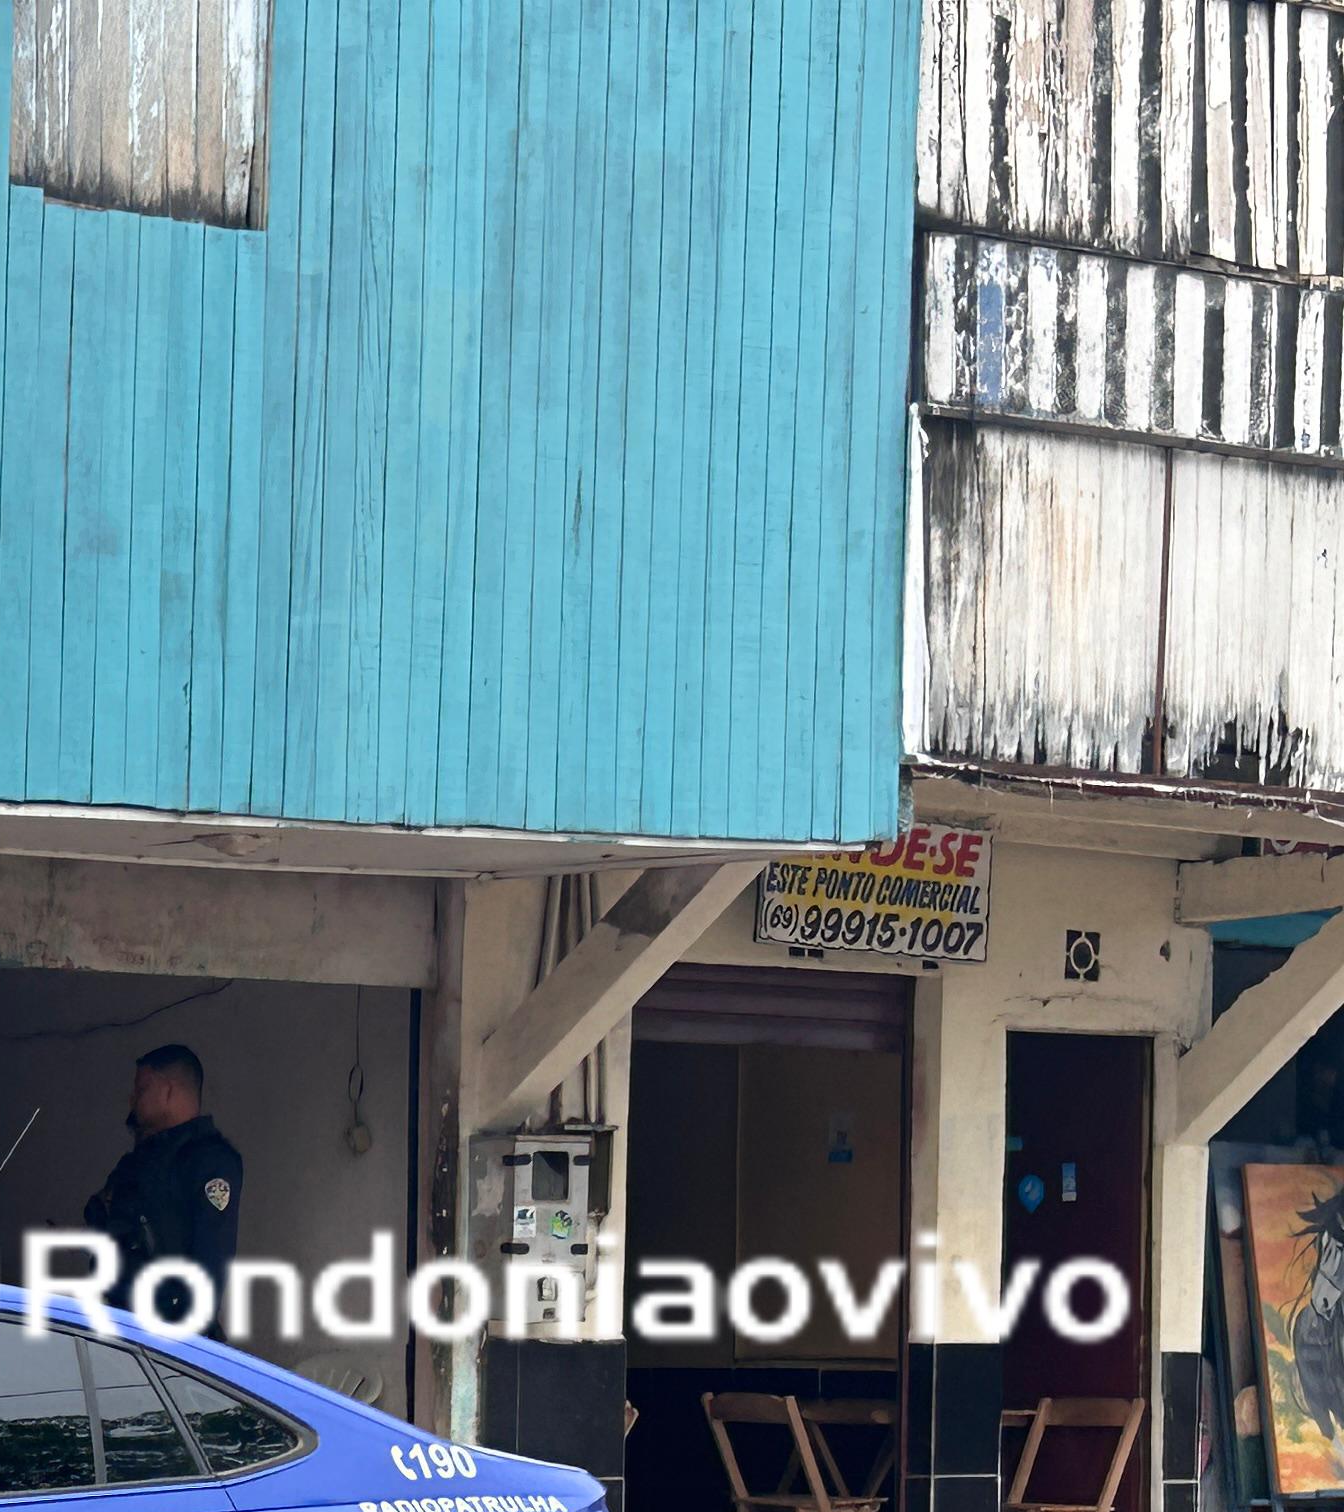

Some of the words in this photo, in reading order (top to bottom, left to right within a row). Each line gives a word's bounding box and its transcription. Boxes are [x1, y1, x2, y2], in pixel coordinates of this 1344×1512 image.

[766, 862, 812, 896] ESTE
[813, 867, 876, 903] PONTO
[876, 875, 981, 914] COMERCIAL
[409, 1443, 478, 1480] 190
